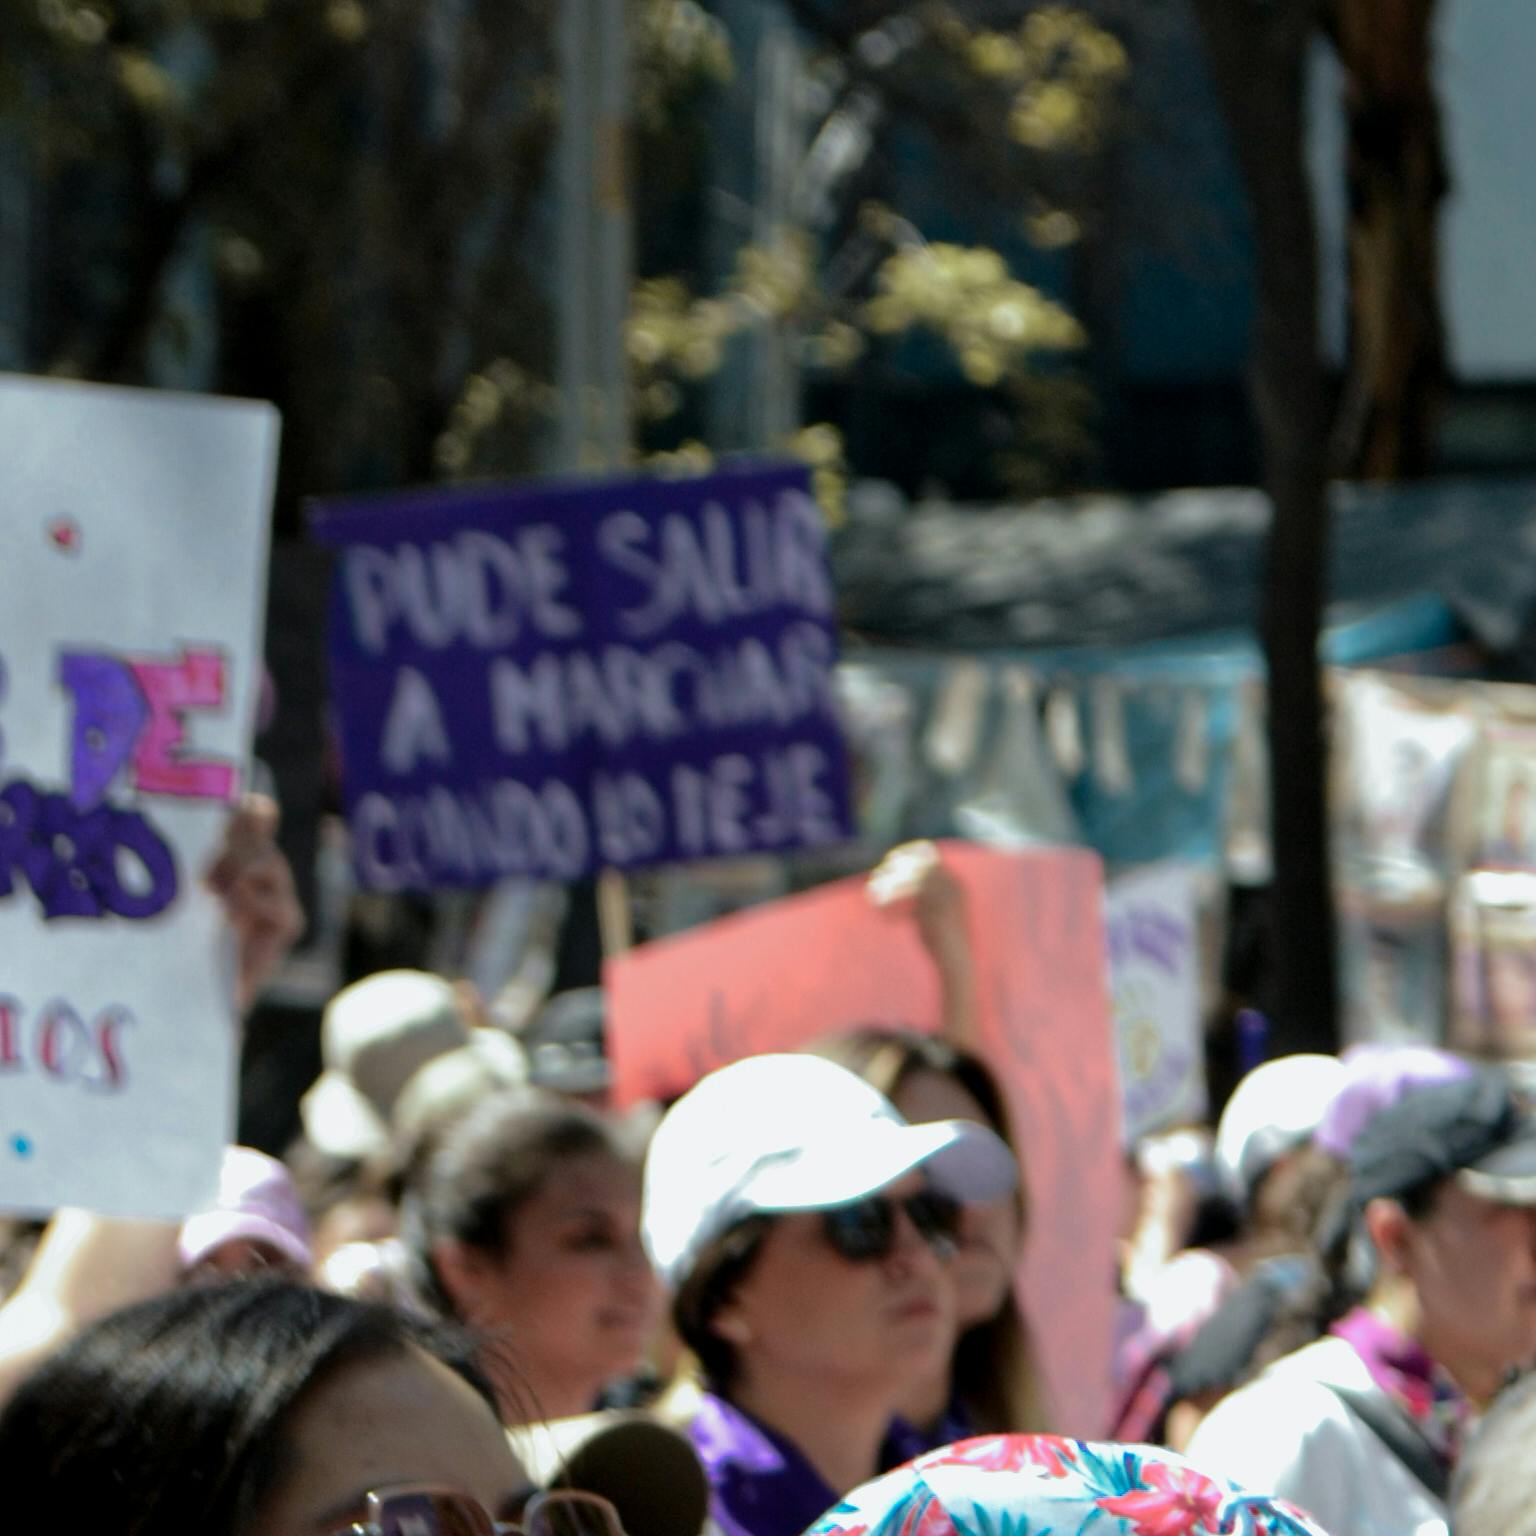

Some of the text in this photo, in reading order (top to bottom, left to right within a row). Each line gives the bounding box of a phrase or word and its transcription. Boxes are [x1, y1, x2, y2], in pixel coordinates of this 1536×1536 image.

[343, 519, 586, 656] PUDE
[56, 646, 238, 812] DE
[379, 664, 452, 774] A
